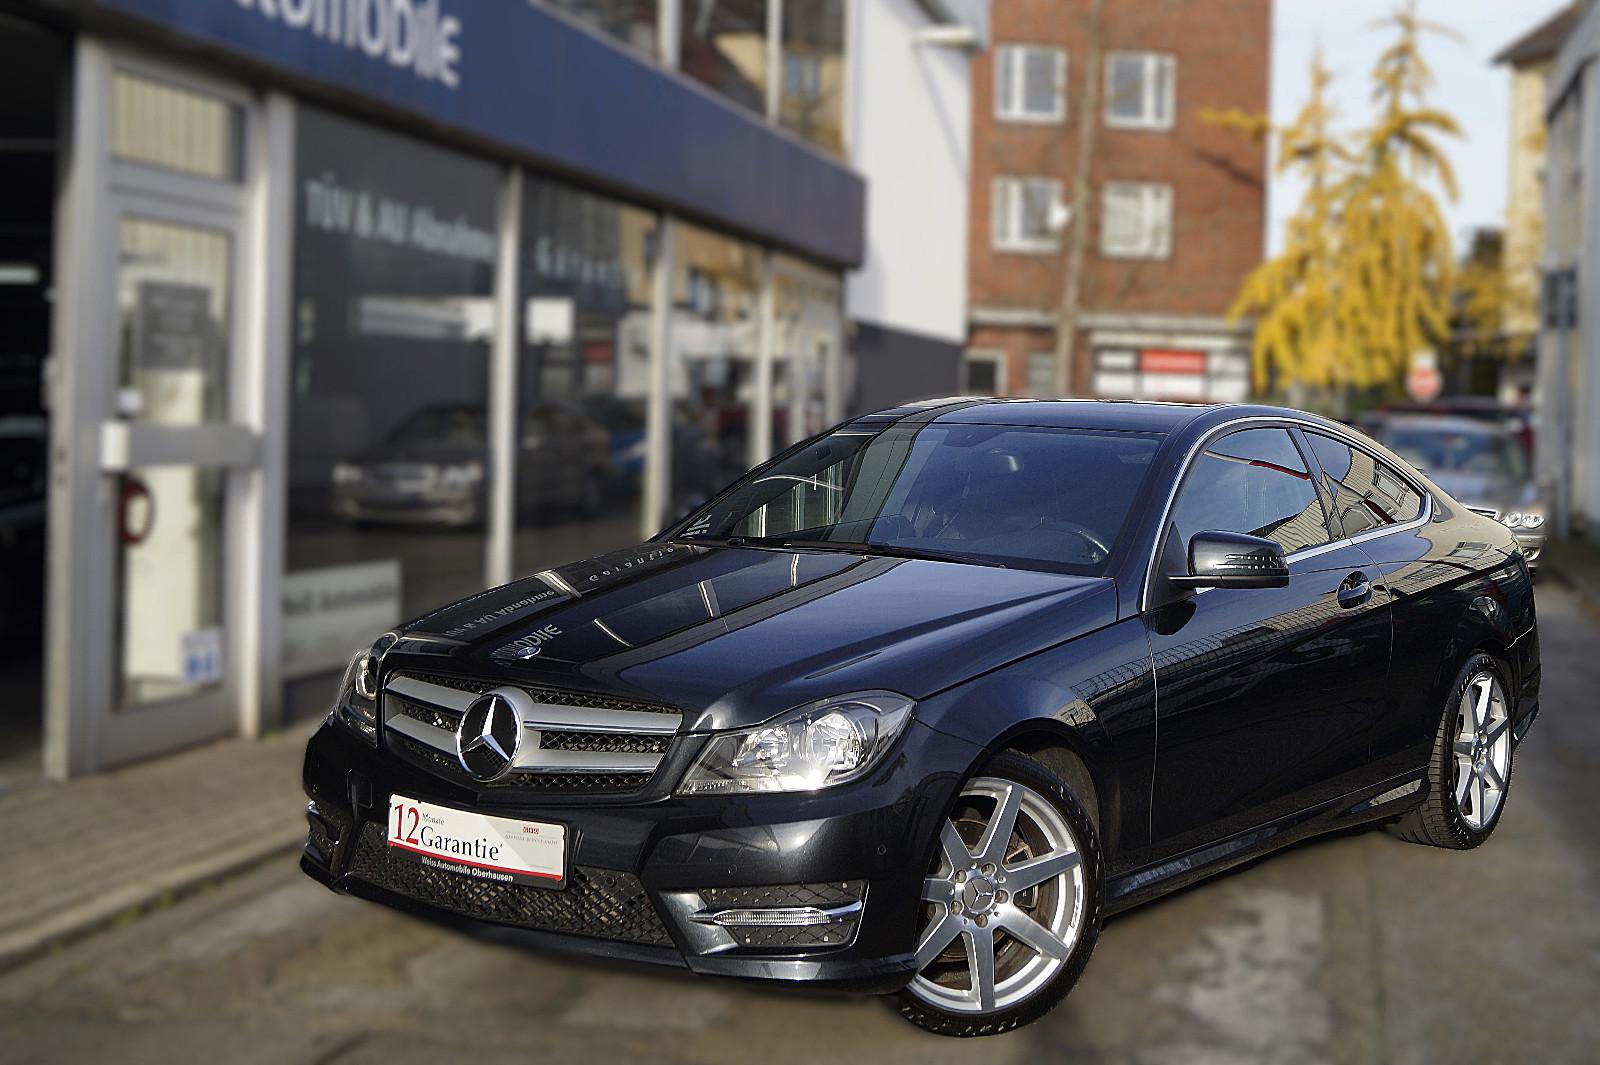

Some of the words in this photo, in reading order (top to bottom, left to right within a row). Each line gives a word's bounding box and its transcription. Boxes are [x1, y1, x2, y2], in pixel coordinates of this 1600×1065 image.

[236, 0, 461, 90] mobile
[394, 803, 420, 846] 12
[420, 825, 500, 862] Garantie
[437, 859, 471, 876] Automobile
[472, 867, 514, 883] Oberhausen
